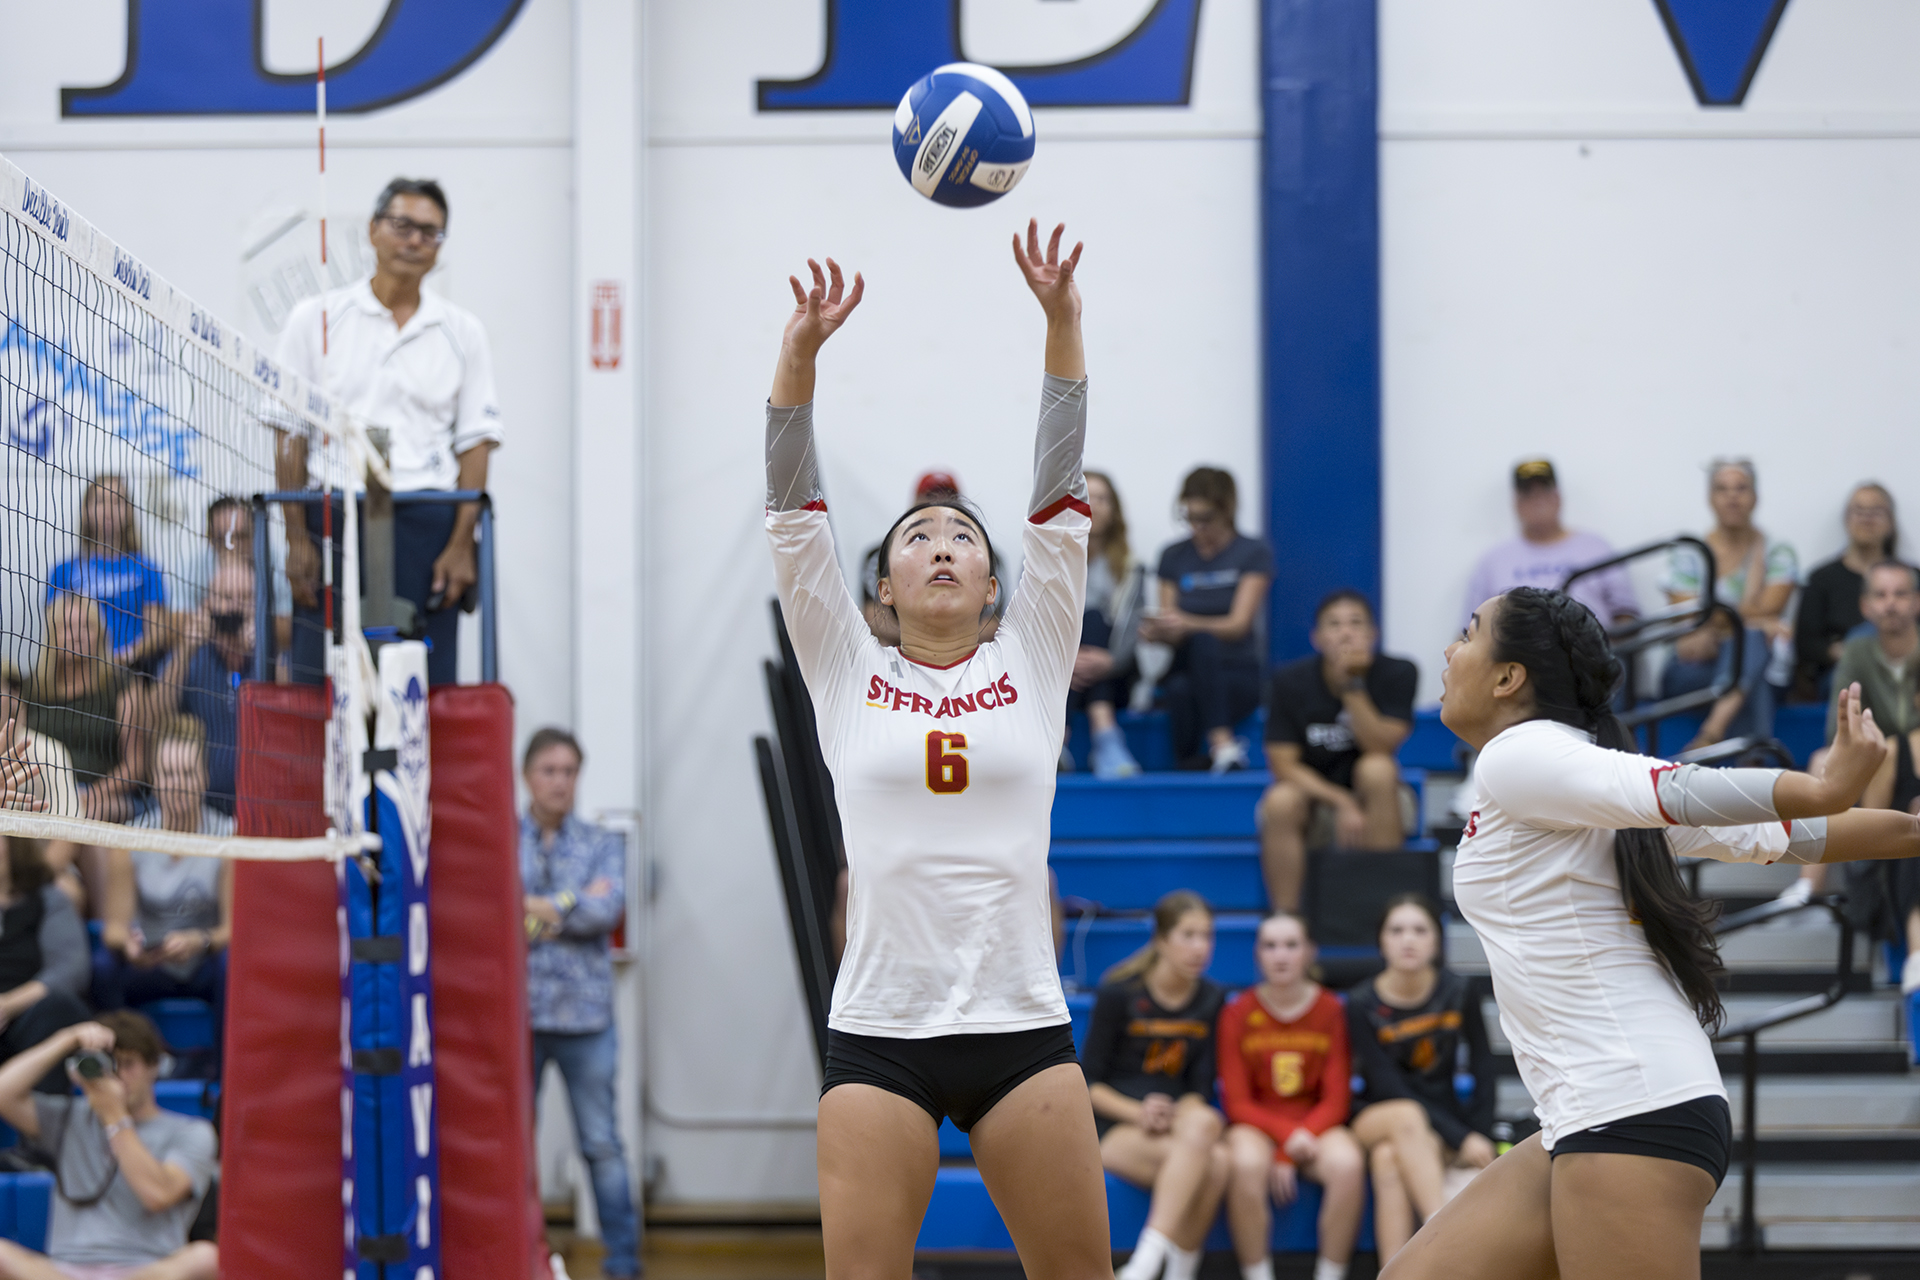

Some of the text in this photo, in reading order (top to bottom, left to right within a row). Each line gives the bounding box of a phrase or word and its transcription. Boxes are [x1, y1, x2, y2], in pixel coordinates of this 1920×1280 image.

[891, 671, 1018, 719] FRANCIS
[926, 729, 970, 795] 6
[408, 901, 433, 1280] DAVI
